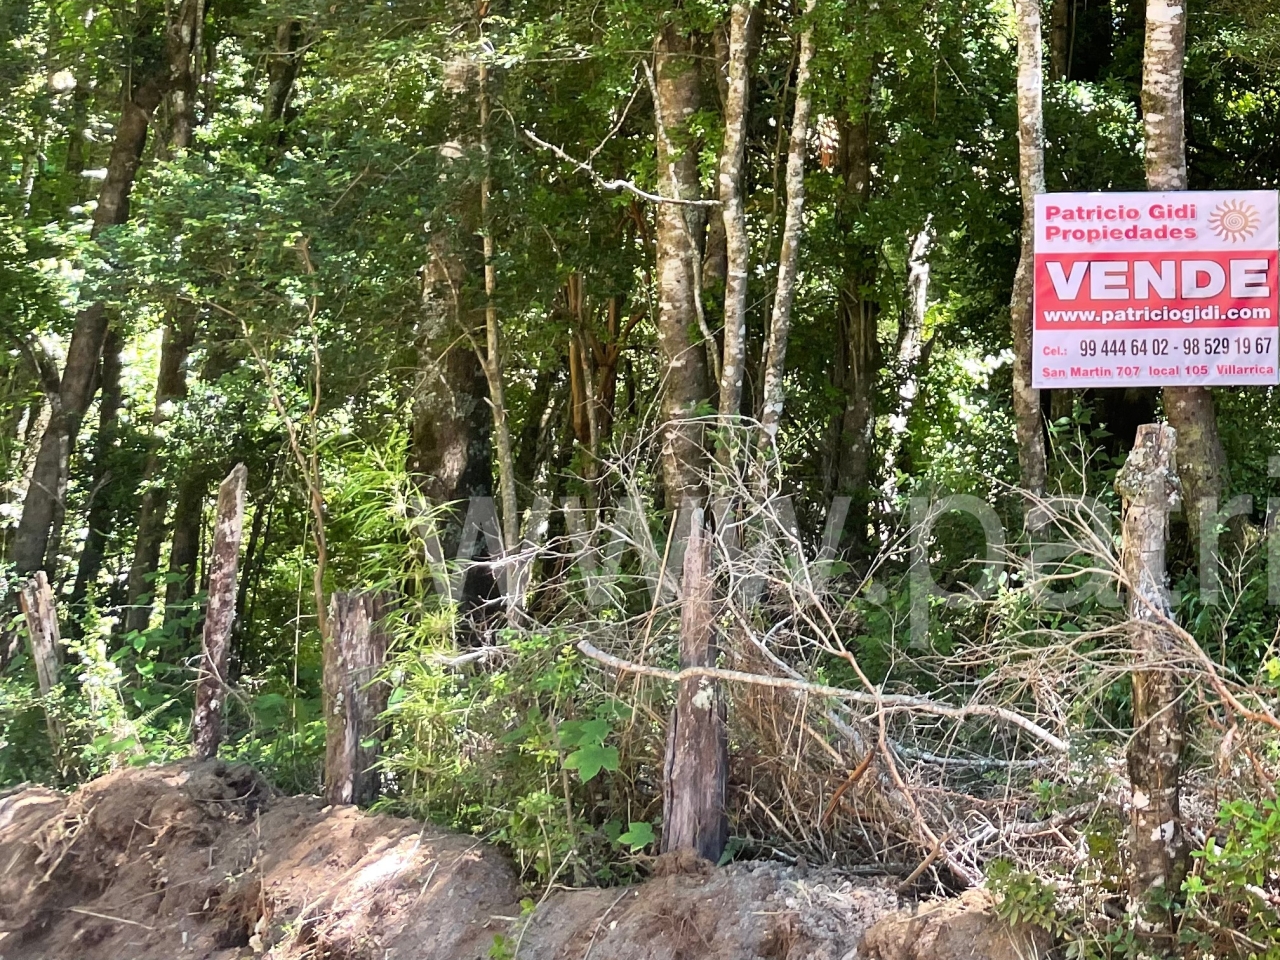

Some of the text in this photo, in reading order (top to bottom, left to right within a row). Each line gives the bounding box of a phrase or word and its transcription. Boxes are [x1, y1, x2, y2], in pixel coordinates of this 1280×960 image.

[1046, 204, 1196, 221] Patricio Gidi
[1046, 226, 1197, 242] Propiedades
[1046, 259, 1270, 300] VENDE
[1044, 306, 1270, 324] www.patriciogidi.com
[1043, 346, 1067, 356] Cel.:
[1080, 340, 1096, 356] 99
[1101, 340, 1126, 356] 444
[1131, 340, 1147, 356] 64
[1152, 339, 1168, 355] 02
[1184, 339, 1199, 355] 98
[1205, 339, 1229, 354] 529
[1235, 338, 1250, 354] 19
[1256, 338, 1271, 354] 67
[1042, 367, 1066, 377] San
[1117, 367, 1139, 376] 707
[1149, 366, 1179, 376] local
[1185, 366, 1207, 375] 105
[1217, 365, 1273, 375] Villarrica
